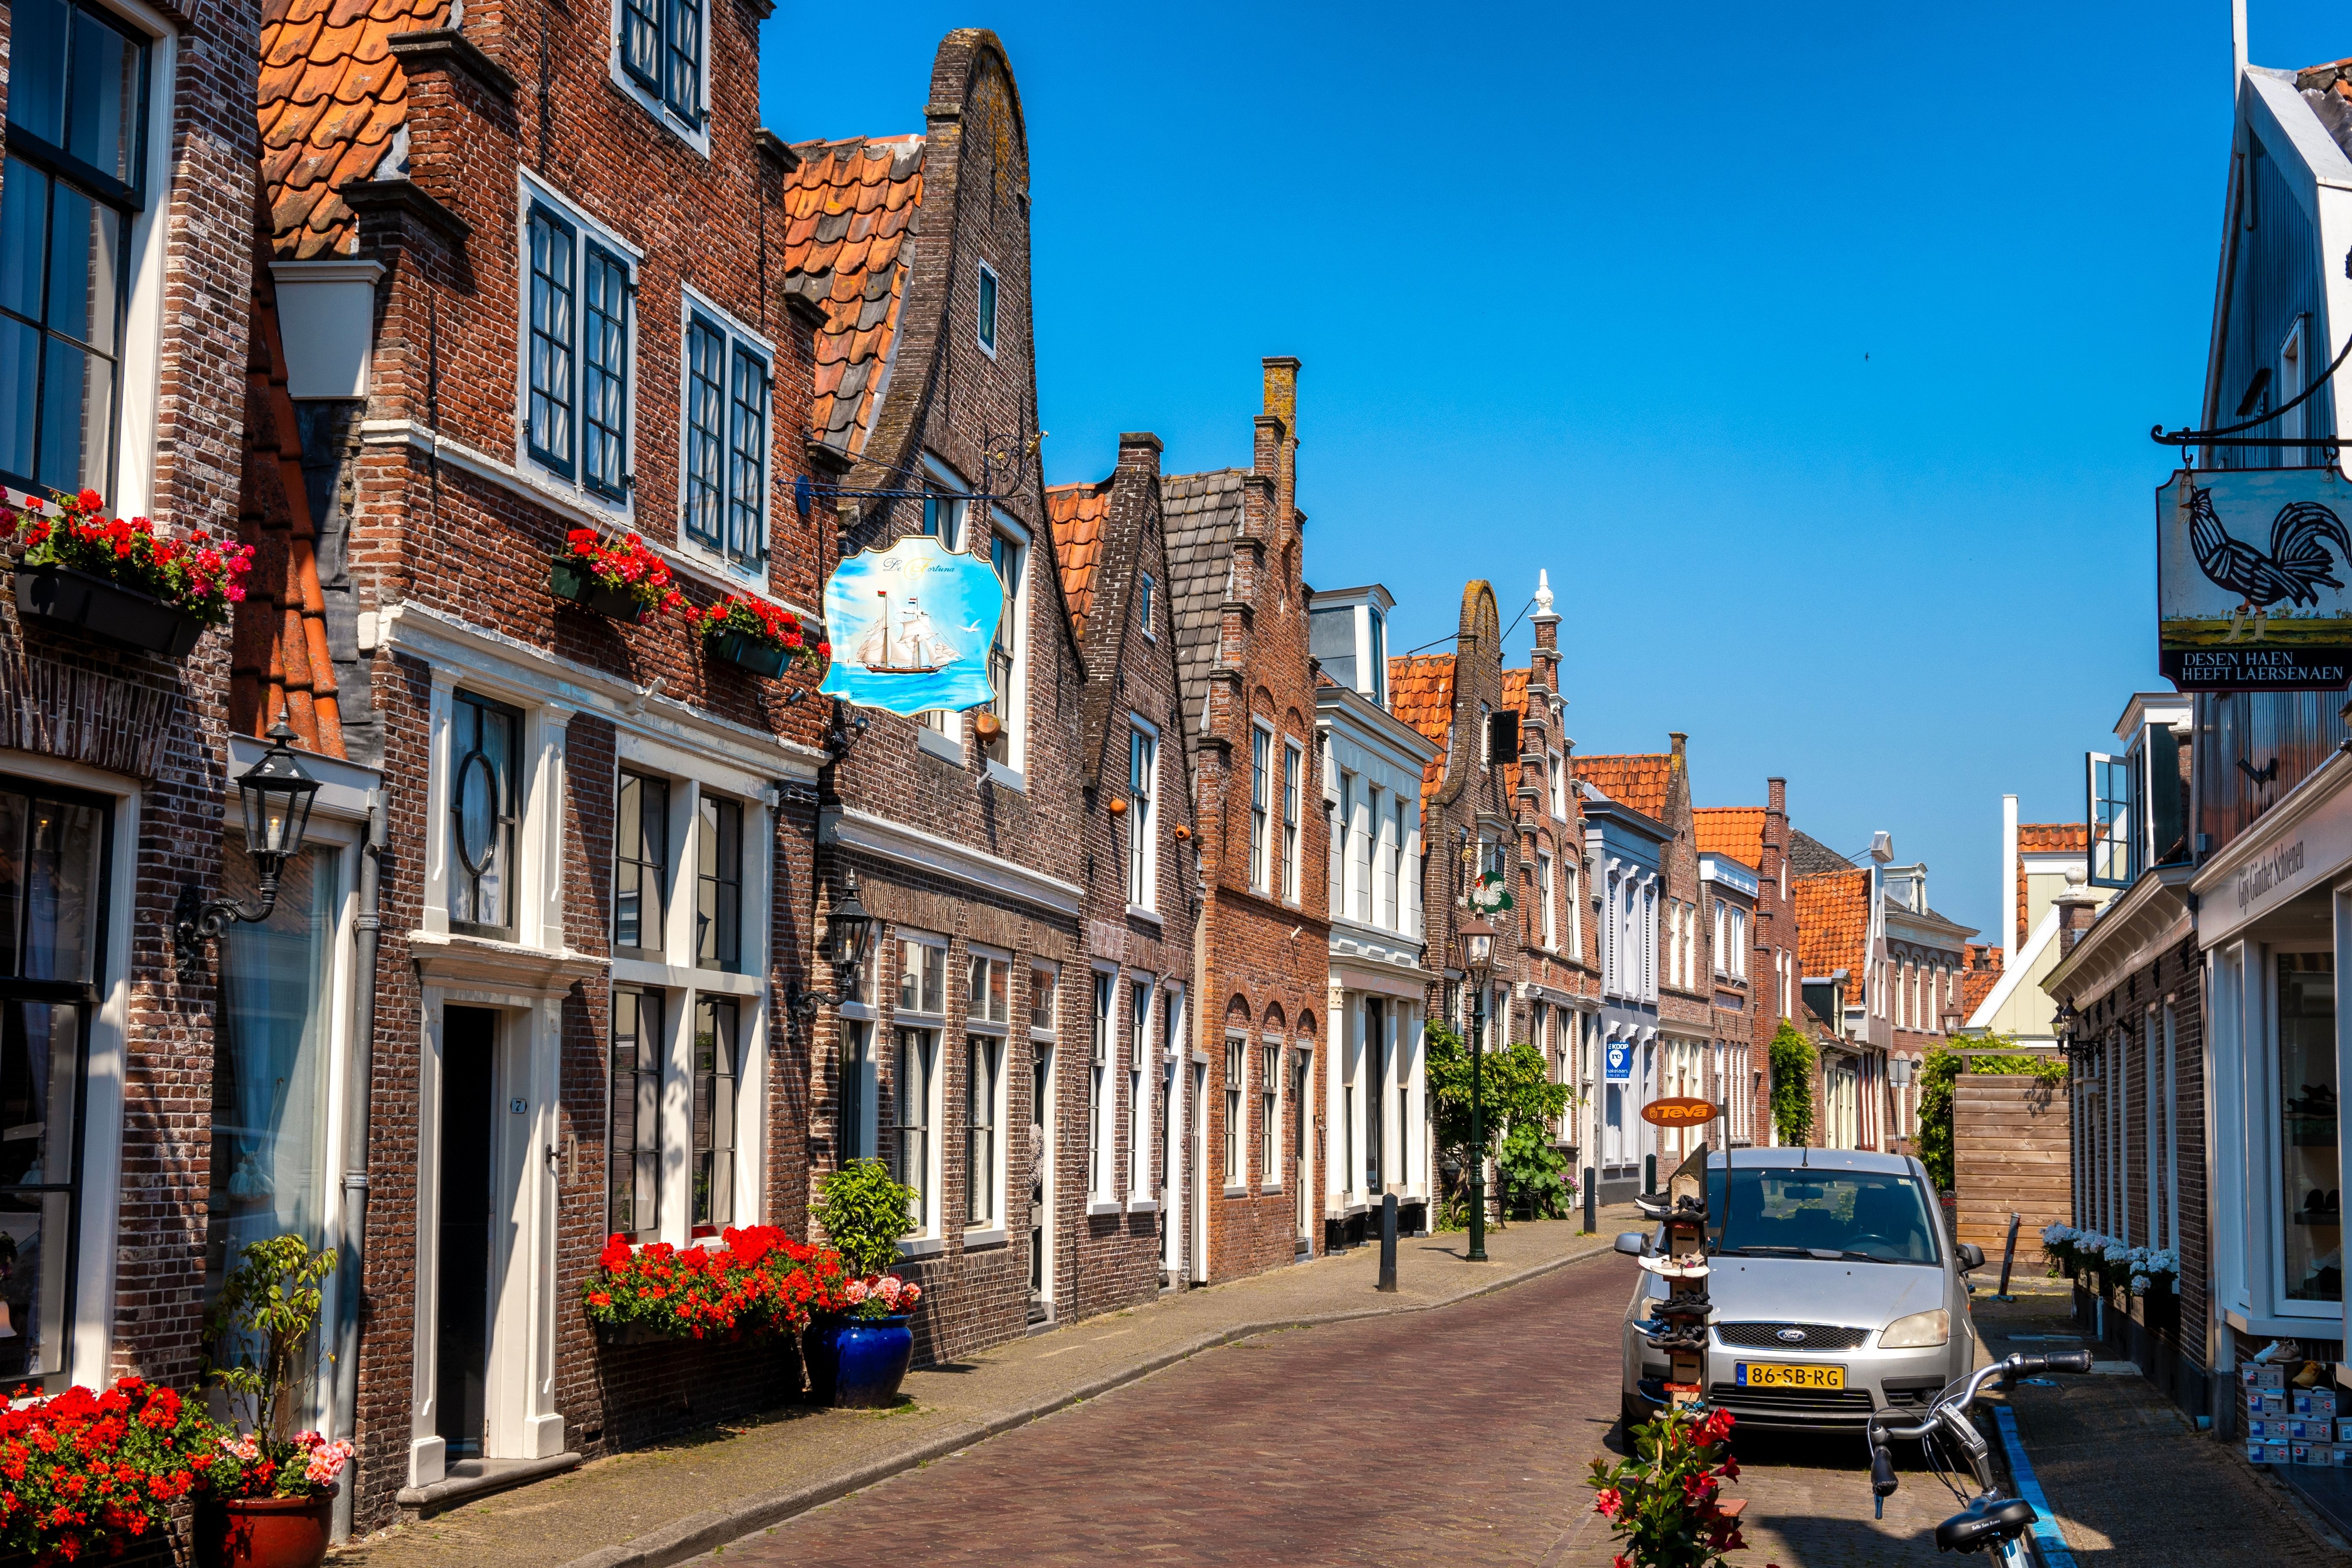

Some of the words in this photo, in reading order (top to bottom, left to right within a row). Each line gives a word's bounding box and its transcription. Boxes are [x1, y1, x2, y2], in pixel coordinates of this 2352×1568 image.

[883, 557, 902, 572] De
[904, 557, 955, 580] Fortuna
[2184, 653, 2238, 666] DESEN
[2246, 651, 2293, 665] HAEN
[2182, 667, 2232, 681] HEEFT
[2238, 869, 2249, 916] Gijs
[2250, 856, 2273, 901] Günther
[2274, 840, 2304, 886] Schoenen
[516, 1100, 521, 1112] 7
[1783, 1331, 1799, 1339] Ford
[1752, 1367, 1838, 1386] 86-SB-RG
